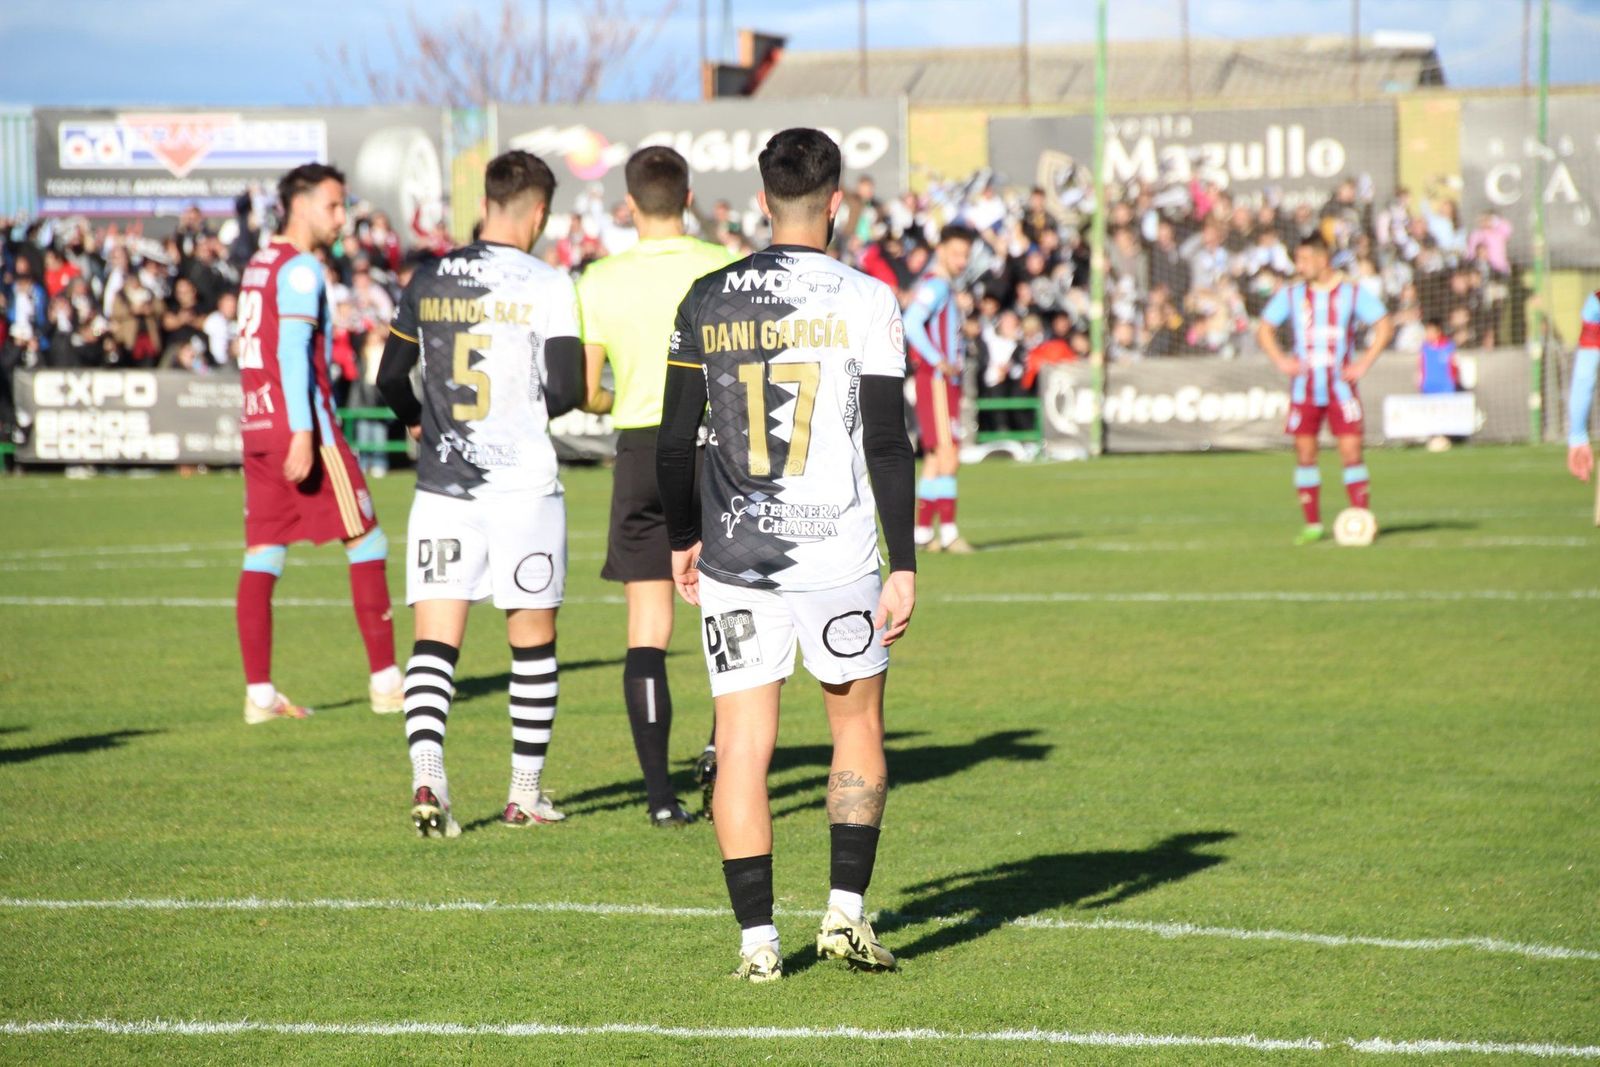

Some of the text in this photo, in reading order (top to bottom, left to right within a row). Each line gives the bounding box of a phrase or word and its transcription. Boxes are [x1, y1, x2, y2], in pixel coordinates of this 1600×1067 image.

[637, 126, 889, 172] IGUO
[722, 269, 792, 293] MMG
[702, 321, 755, 354] DANI
[761, 312, 850, 350] GARCÍA
[34, 371, 158, 407] EXPO
[453, 333, 491, 421] 5
[738, 361, 821, 476] 17
[1074, 385, 1291, 424] BricoCentr
[36, 434, 180, 460] COCINAS
[756, 502, 840, 519] TERNERA
[758, 517, 838, 536] CHARRA
